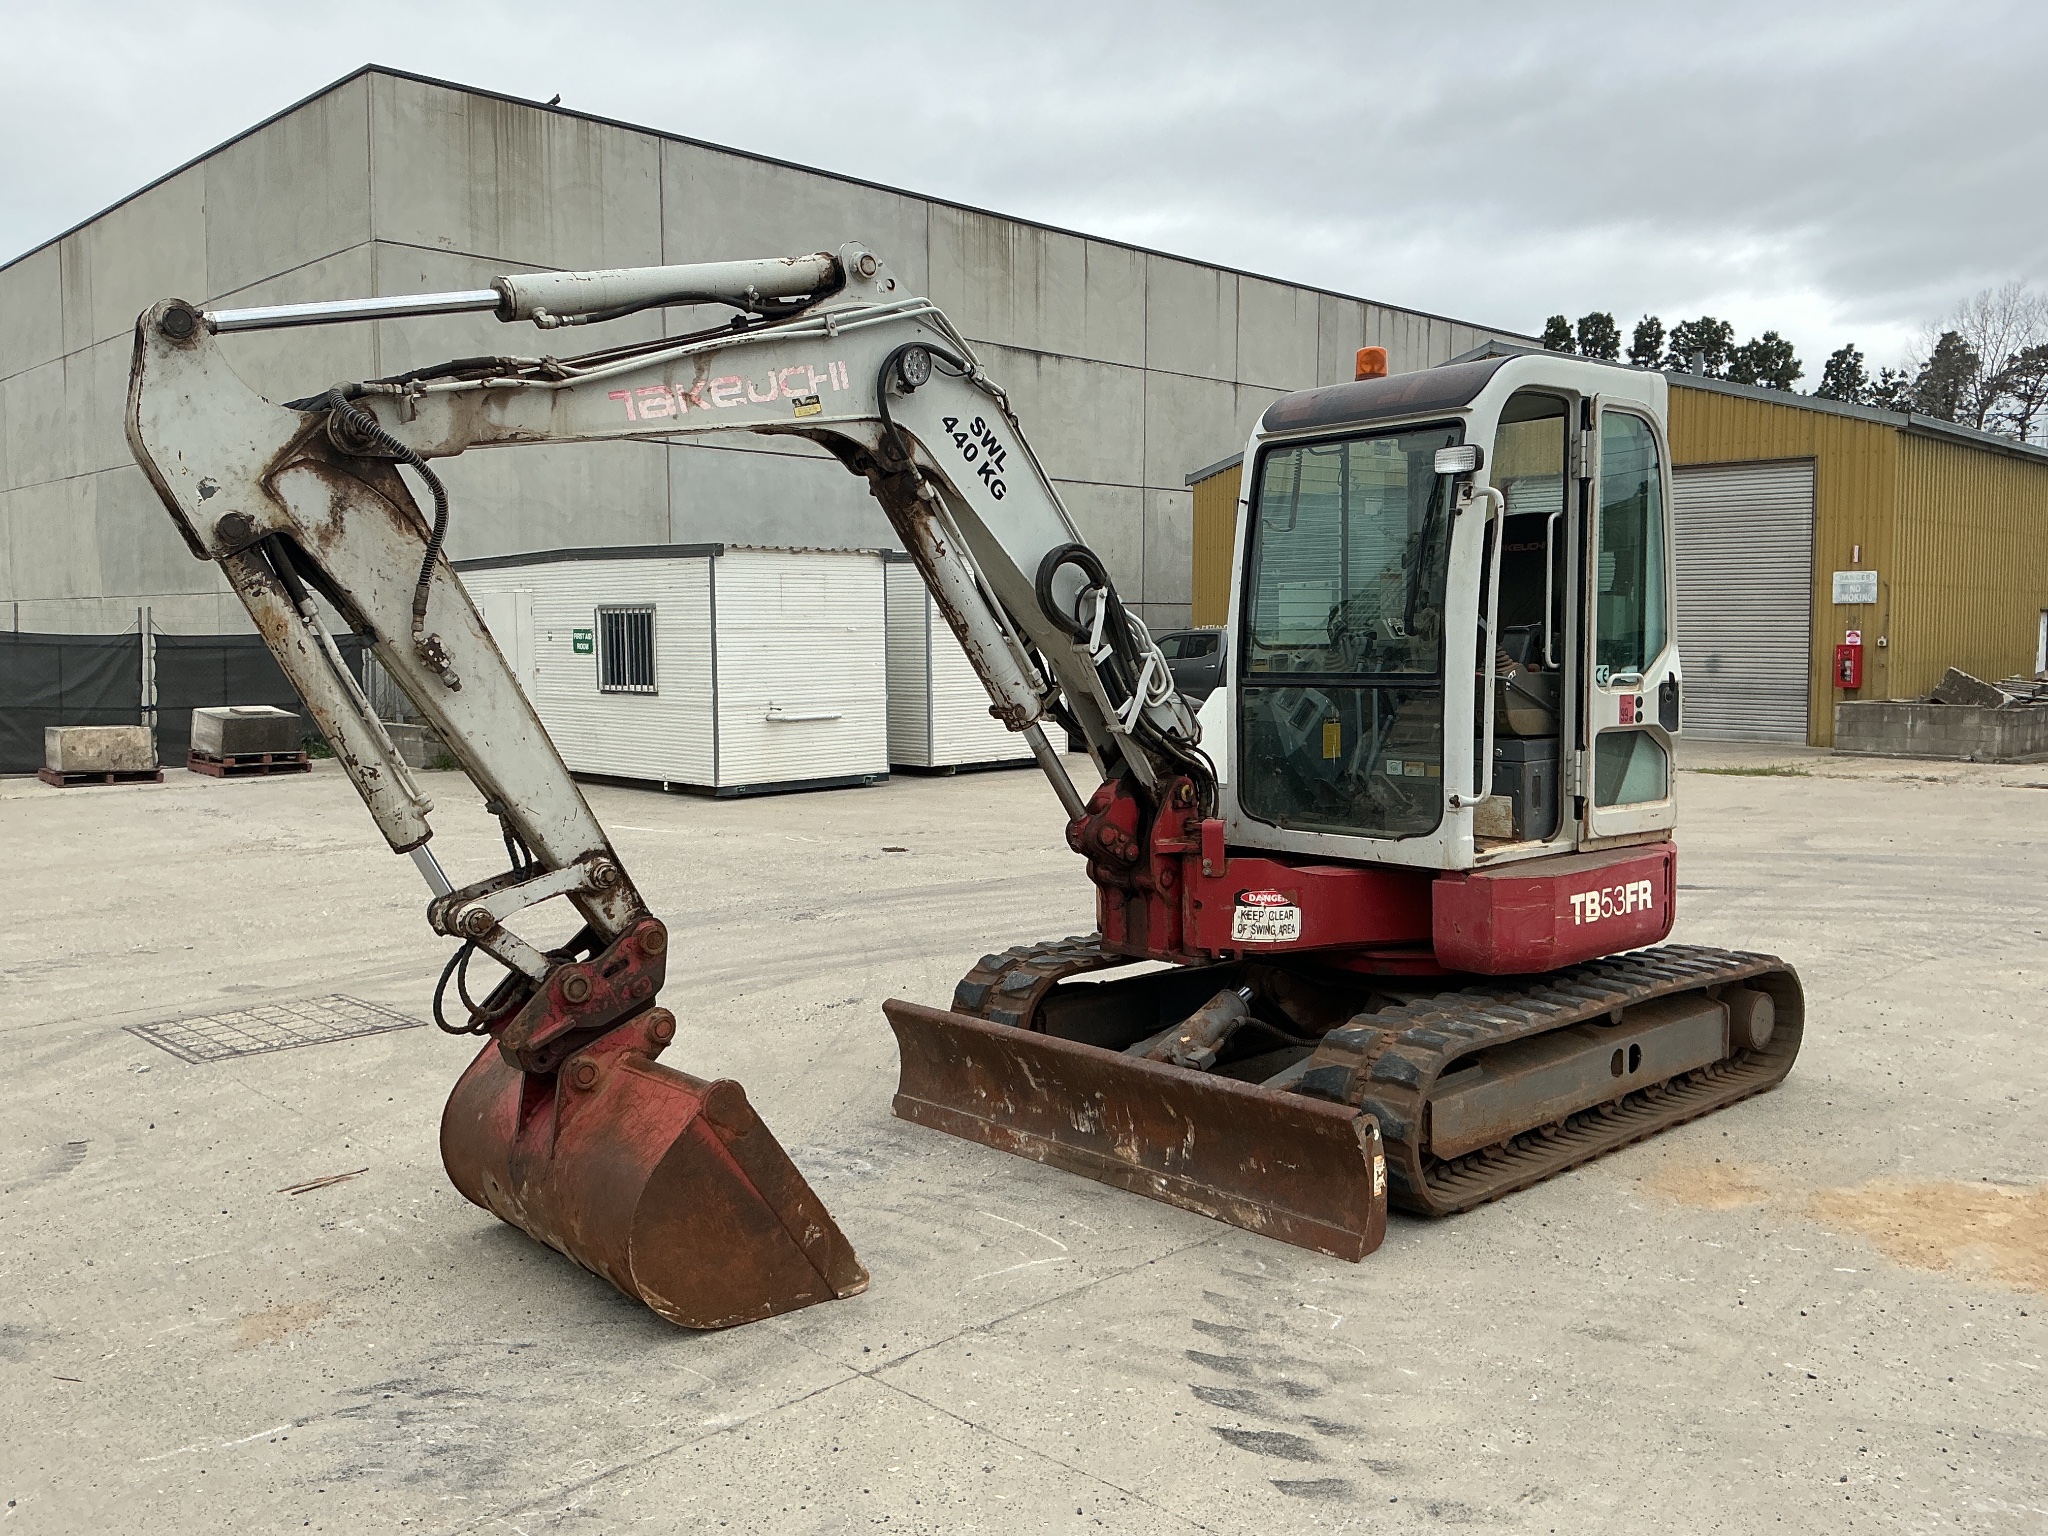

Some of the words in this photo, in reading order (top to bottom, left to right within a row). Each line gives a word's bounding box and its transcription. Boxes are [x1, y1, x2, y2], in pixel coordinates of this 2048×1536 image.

[970, 416, 1007, 473] SWL
[942, 417, 978, 462] 440
[977, 461, 1007, 501] KG
[1849, 584, 1861, 593] NO
[1838, 593, 1873, 602] SMOKING
[1596, 667, 1608, 684] CE
[1620, 707, 1629, 722] 99
[1569, 879, 1653, 926] TB53FR
[1241, 909, 1264, 921] KEEP
[1268, 909, 1294, 921] CLEAR
[1237, 923, 1248, 935] OF
[1251, 923, 1276, 935] SWING
[1279, 924, 1296, 935] AREA
